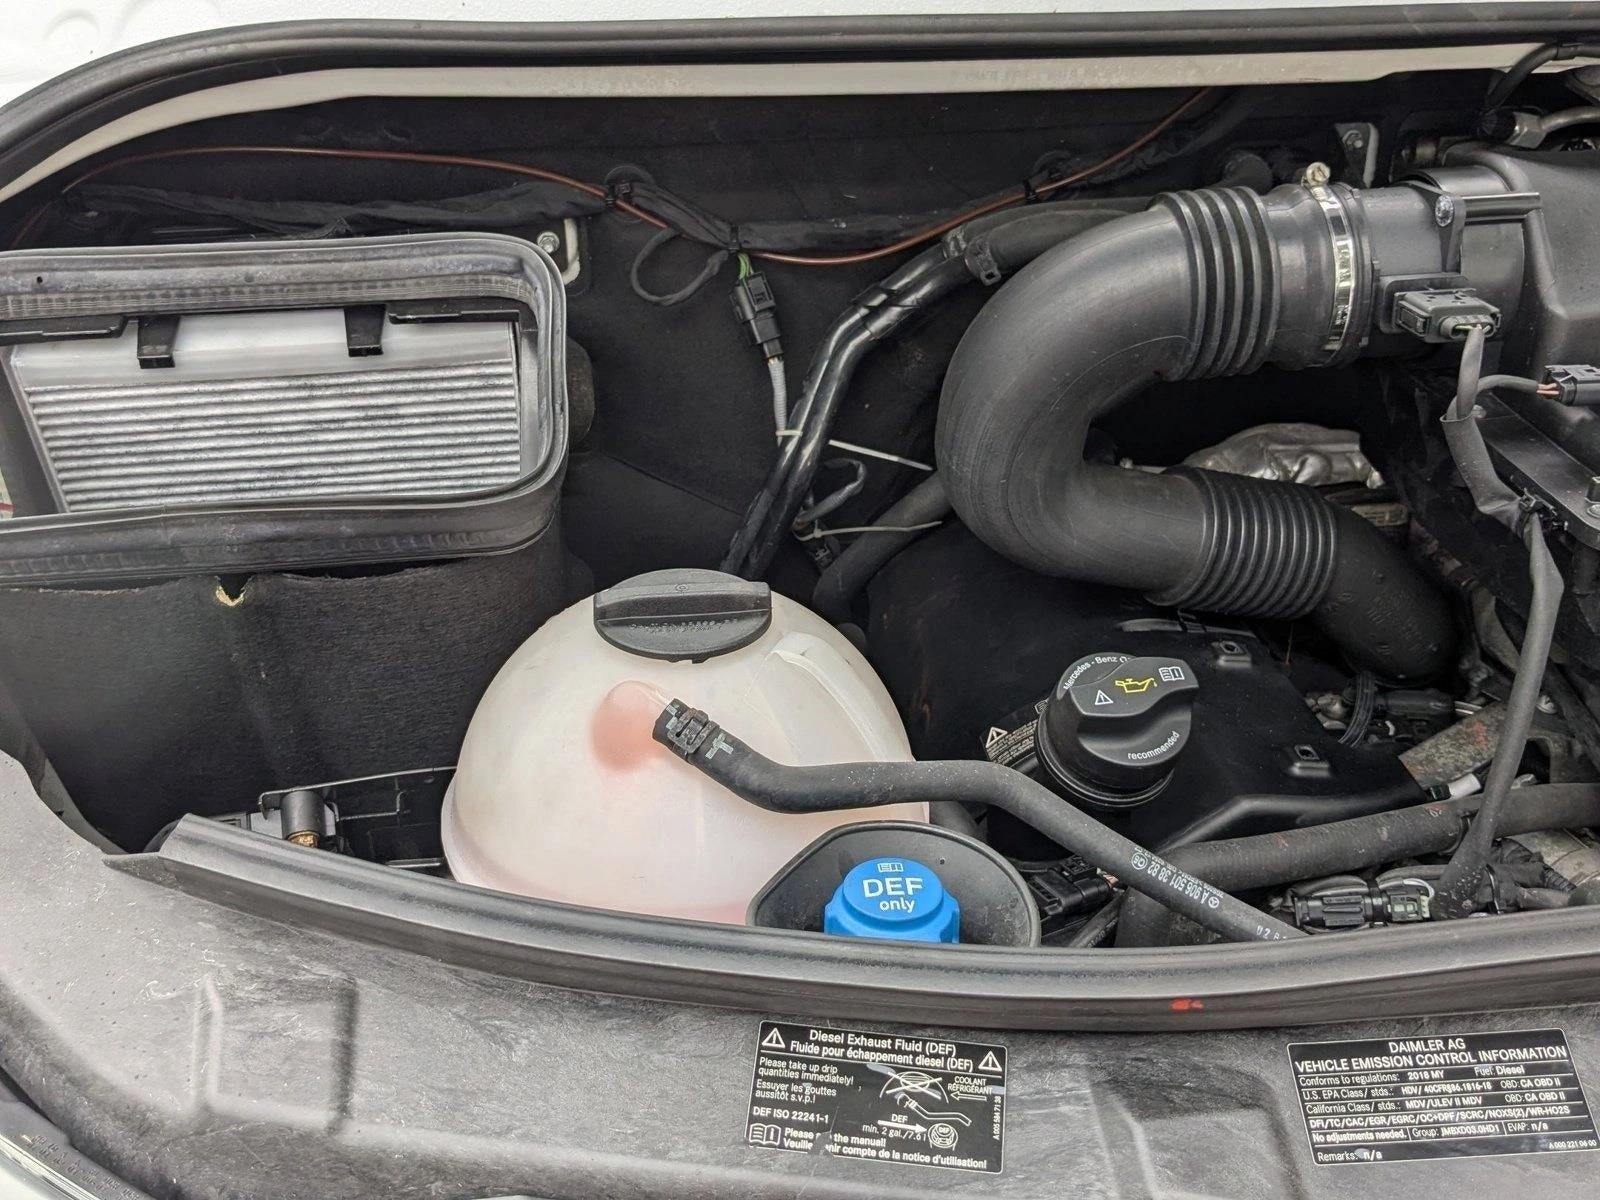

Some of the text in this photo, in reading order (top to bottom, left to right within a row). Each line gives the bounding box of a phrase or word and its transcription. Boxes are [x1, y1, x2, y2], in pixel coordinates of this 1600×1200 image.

[1127, 730, 1179, 760] recommended
[1147, 861, 1161, 877] 82
[1157, 868, 1171, 883] 38
[862, 877, 924, 898] DEF
[1169, 873, 1187, 892] 501
[1185, 881, 1203, 900] 906
[1200, 889, 1210, 904] A
[879, 896, 915, 914] only
[809, 1029, 957, 1057] Diesel Exhaust Fluid (DEF)
[1388, 1037, 1466, 1053] DAIMLER AG
[790, 1040, 974, 1073] Fluide pour échappement diesel (DEF)
[1294, 1045, 1568, 1073] VEHICLE EMISSION CONTROL INFORMATION
[759, 1056, 838, 1075] Please take up drip
[1474, 1064, 1525, 1076] Fuel: Diesel
[758, 1066, 854, 1086] quantities immediately!
[954, 1075, 987, 1086] COOLANT
[1299, 1069, 1445, 1087] Conforms to regulations: 2018 MY
[1500, 1077, 1561, 1089] OBD: CA OBD II
[755, 1089, 789, 1101] aussitôt
[756, 1078, 837, 1097] Essuyer les gouttes
[947, 1082, 993, 1095] RÉFRIGÉRANT
[1302, 1091, 1321, 1101] U.S.
[1322, 1090, 1339, 1100] EPA
[1340, 1088, 1368, 1099] Class/
[1401, 1085, 1422, 1095] HDV/
[1306, 1102, 1346, 1114] California
[1347, 1101, 1375, 1113] Class/
[1404, 1097, 1453, 1109] MDV/ULEV
[1454, 1097, 1461, 1106] II
[1461, 1095, 1483, 1106] MDV
[1504, 1090, 1566, 1103] OBD: CA OBD II
[752, 1106, 829, 1124] DEF ISO 22241-1
[891, 1113, 908, 1124] DEF
[784, 1127, 814, 1139] Please
[862, 1124, 880, 1134] min.
[881, 1127, 887, 1135] 2
[1411, 1128, 1440, 1138] Group:
[1507, 1121, 1549, 1132] EVAP: n/a
[833, 1132, 849, 1143] the
[850, 1136, 887, 1148] manual!
[1311, 1129, 1407, 1144] No adjustments needed.
[842, 1145, 877, 1157] compte
[878, 1148, 890, 1159] de
[891, 1149, 901, 1159] la
[902, 1151, 931, 1163] notice
[932, 1154, 987, 1169] d'utilisation!
[1317, 1150, 1383, 1162] Remarks: n/a
